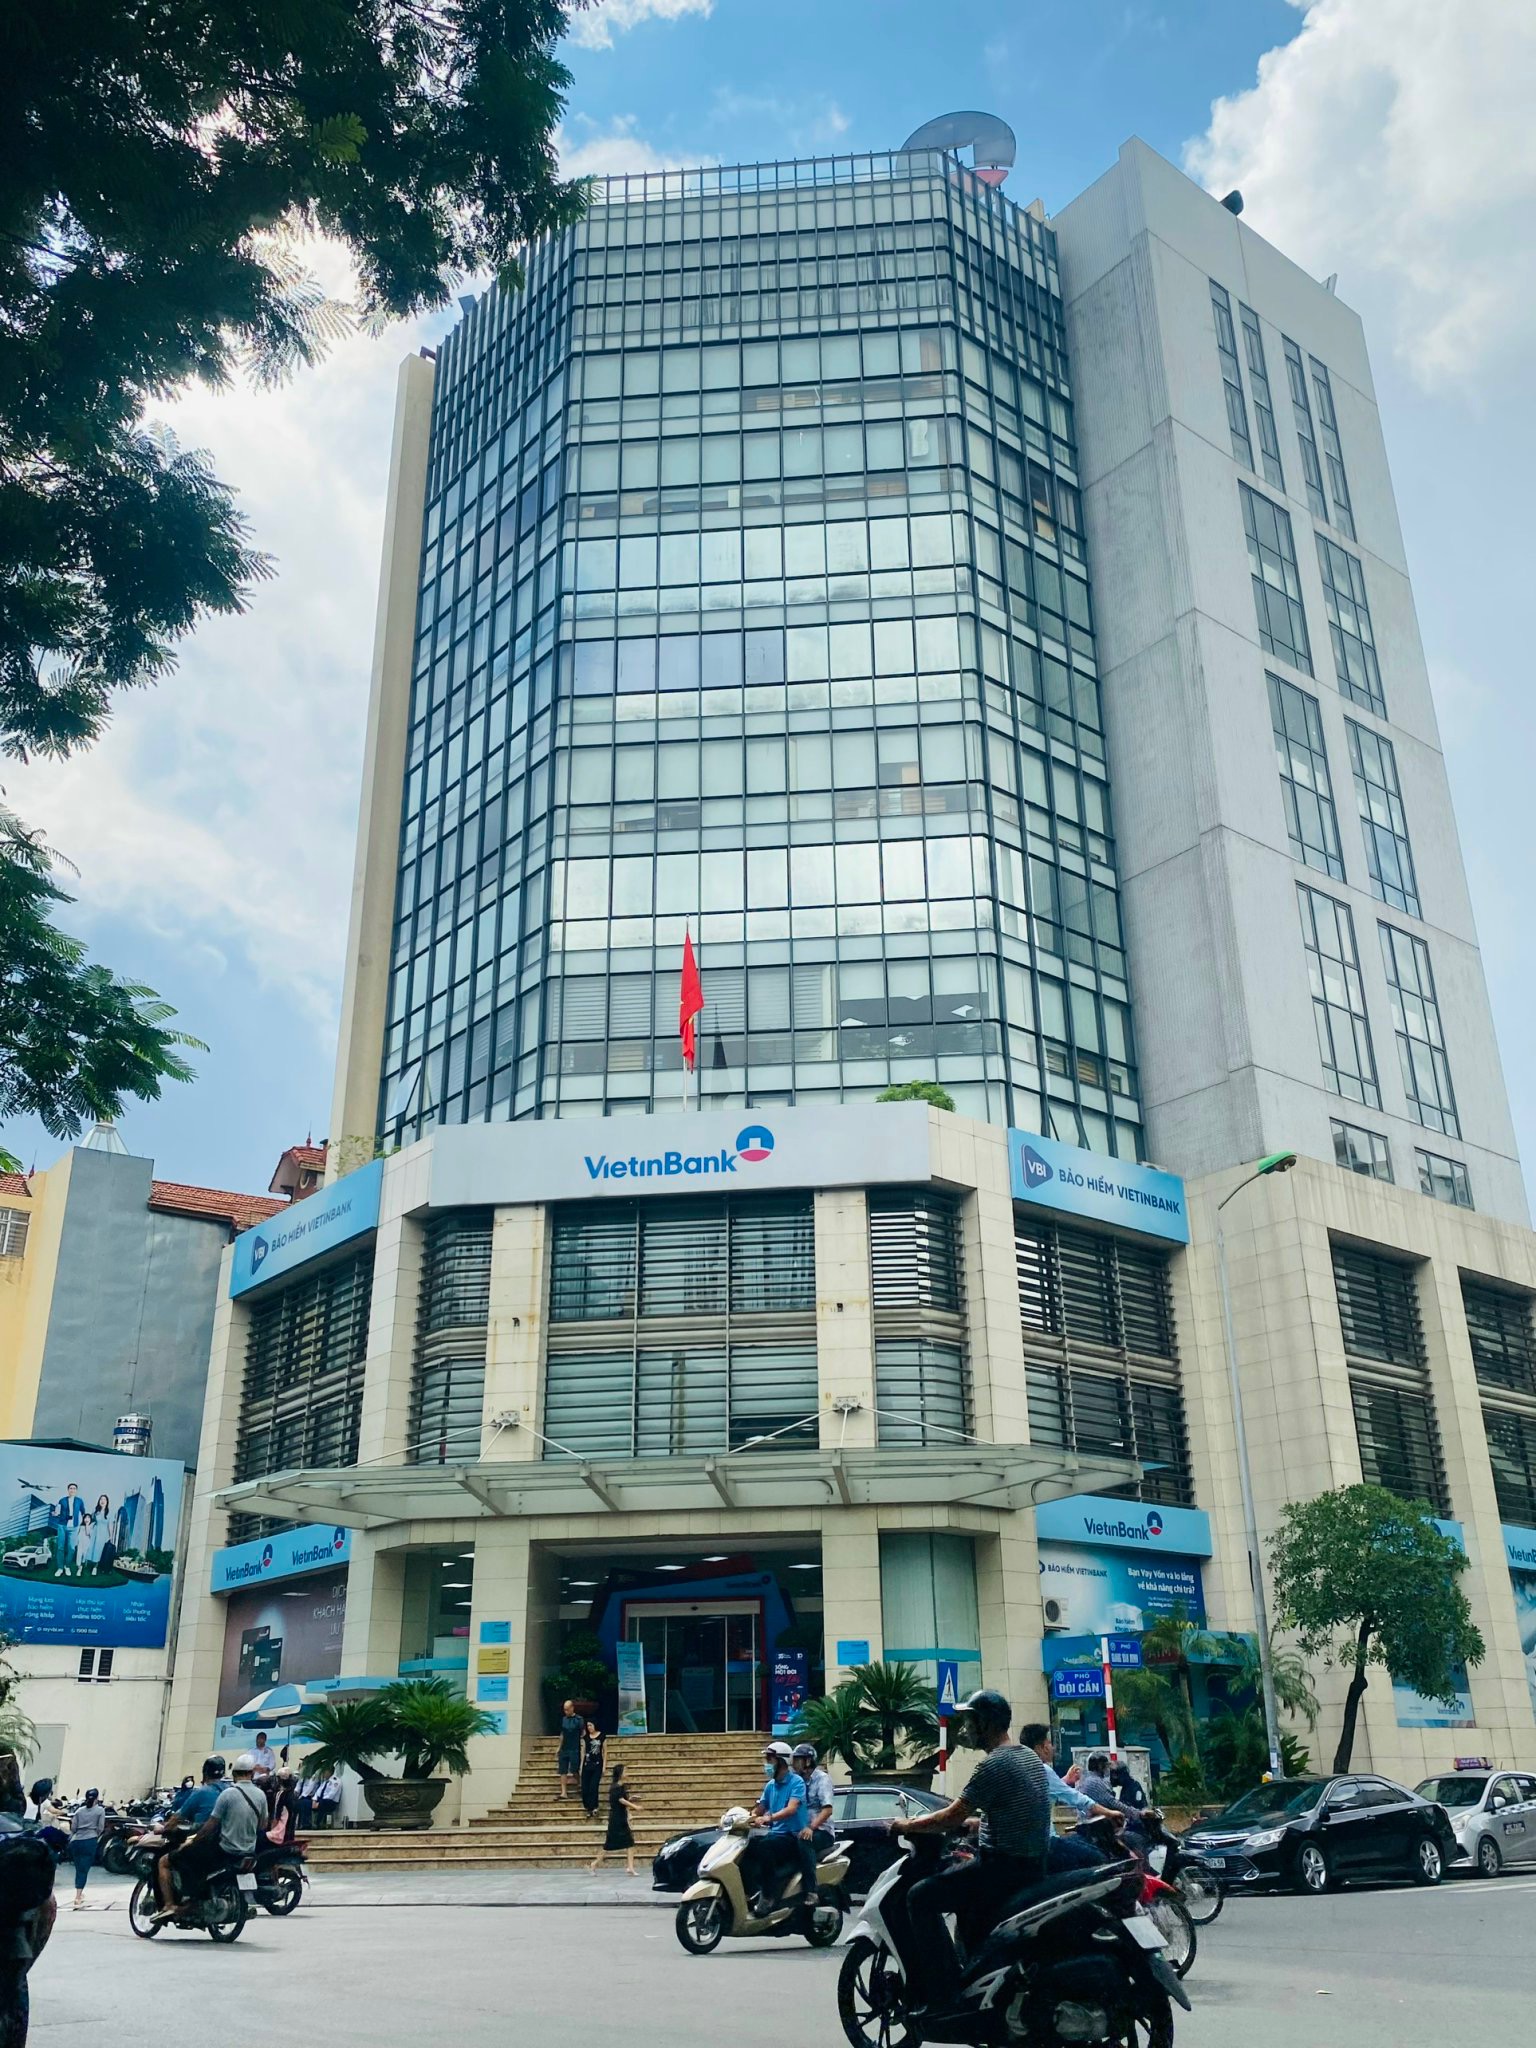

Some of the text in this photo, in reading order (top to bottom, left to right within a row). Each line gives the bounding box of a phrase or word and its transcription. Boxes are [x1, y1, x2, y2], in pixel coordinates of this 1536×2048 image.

[584, 1149, 737, 1180] VietinBank
[1027, 1160, 1047, 1178] VBI
[1059, 1167, 1180, 1215] BẢO HIỂM VIETINBANK
[271, 1199, 352, 1252] BẢO HIỂM VIETINBANK
[1084, 1516, 1150, 1541] VietinBank
[292, 1542, 334, 1566] VietinBank
[225, 1559, 263, 1581] VietinBank
[1127, 1567, 1140, 1578] Bạn
[1074, 1671, 1090, 1679] PHỐ
[1059, 1679, 1100, 1696] ĐỘI CẤN
